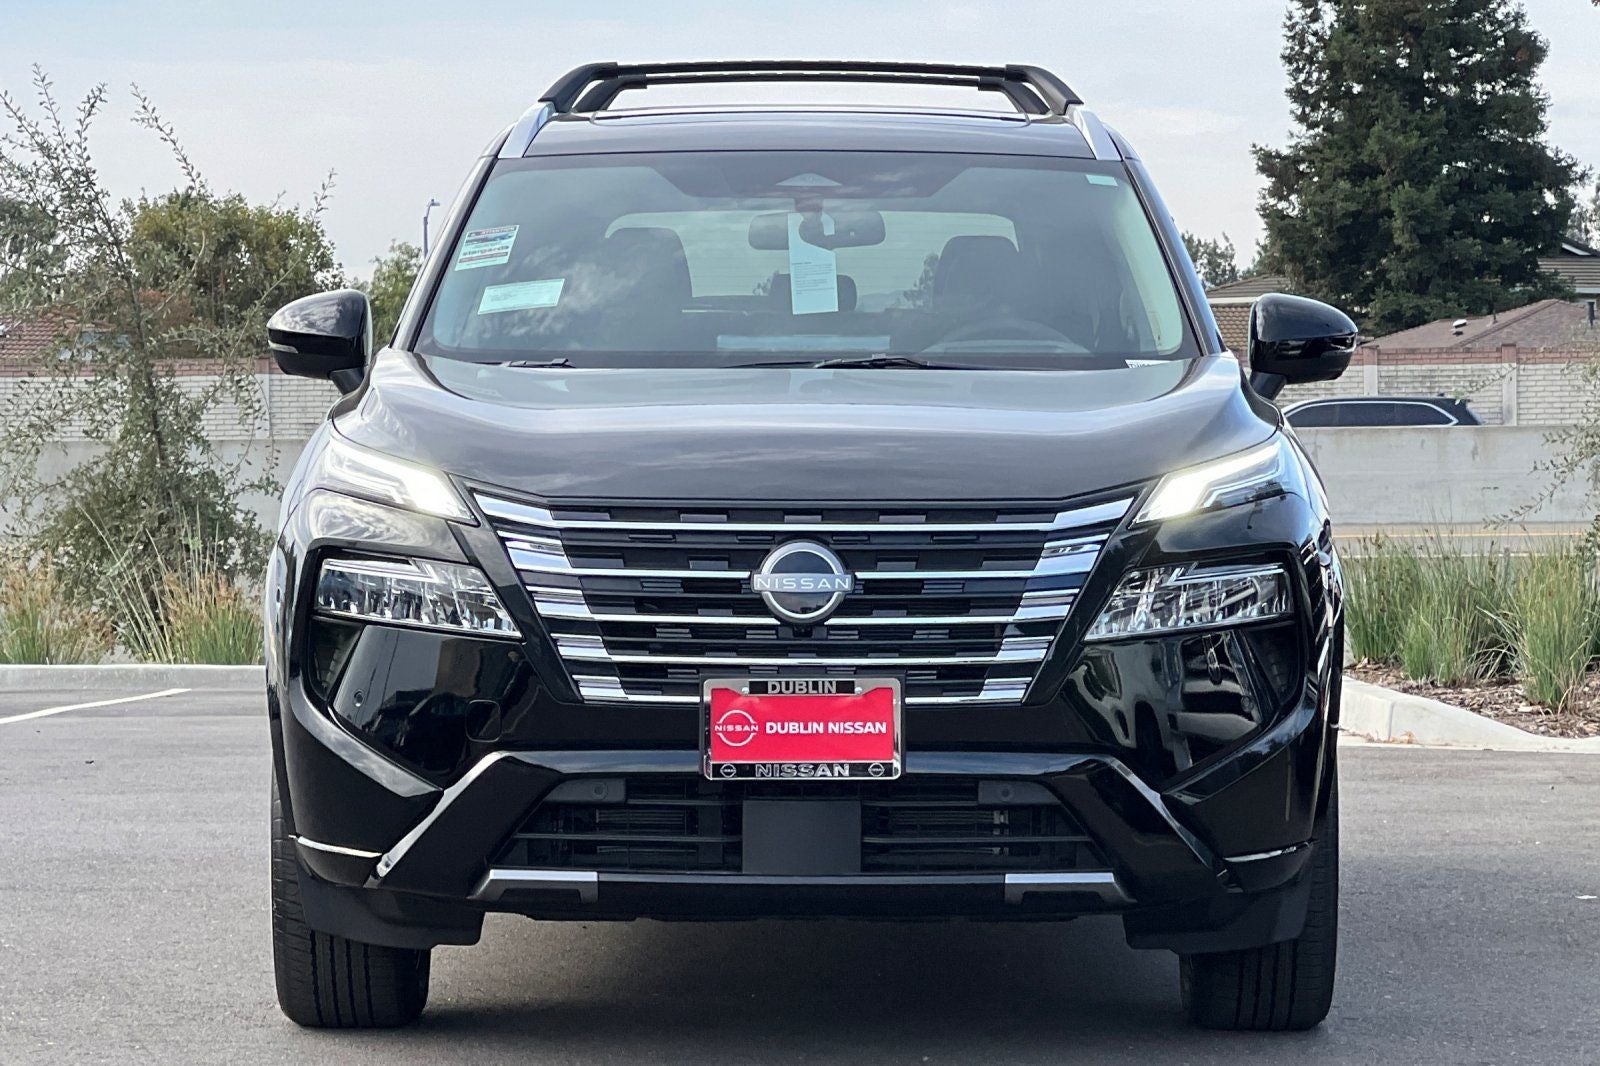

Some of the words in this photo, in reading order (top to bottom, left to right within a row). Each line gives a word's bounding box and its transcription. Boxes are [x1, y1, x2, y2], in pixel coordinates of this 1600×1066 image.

[757, 578, 849, 589] NISSAN
[767, 680, 837, 694] DUBLIN
[714, 724, 759, 732] NISSAN
[765, 721, 824, 734] DUBLIN
[828, 721, 887, 734] NISSAN
[755, 763, 850, 777] NISSAN
